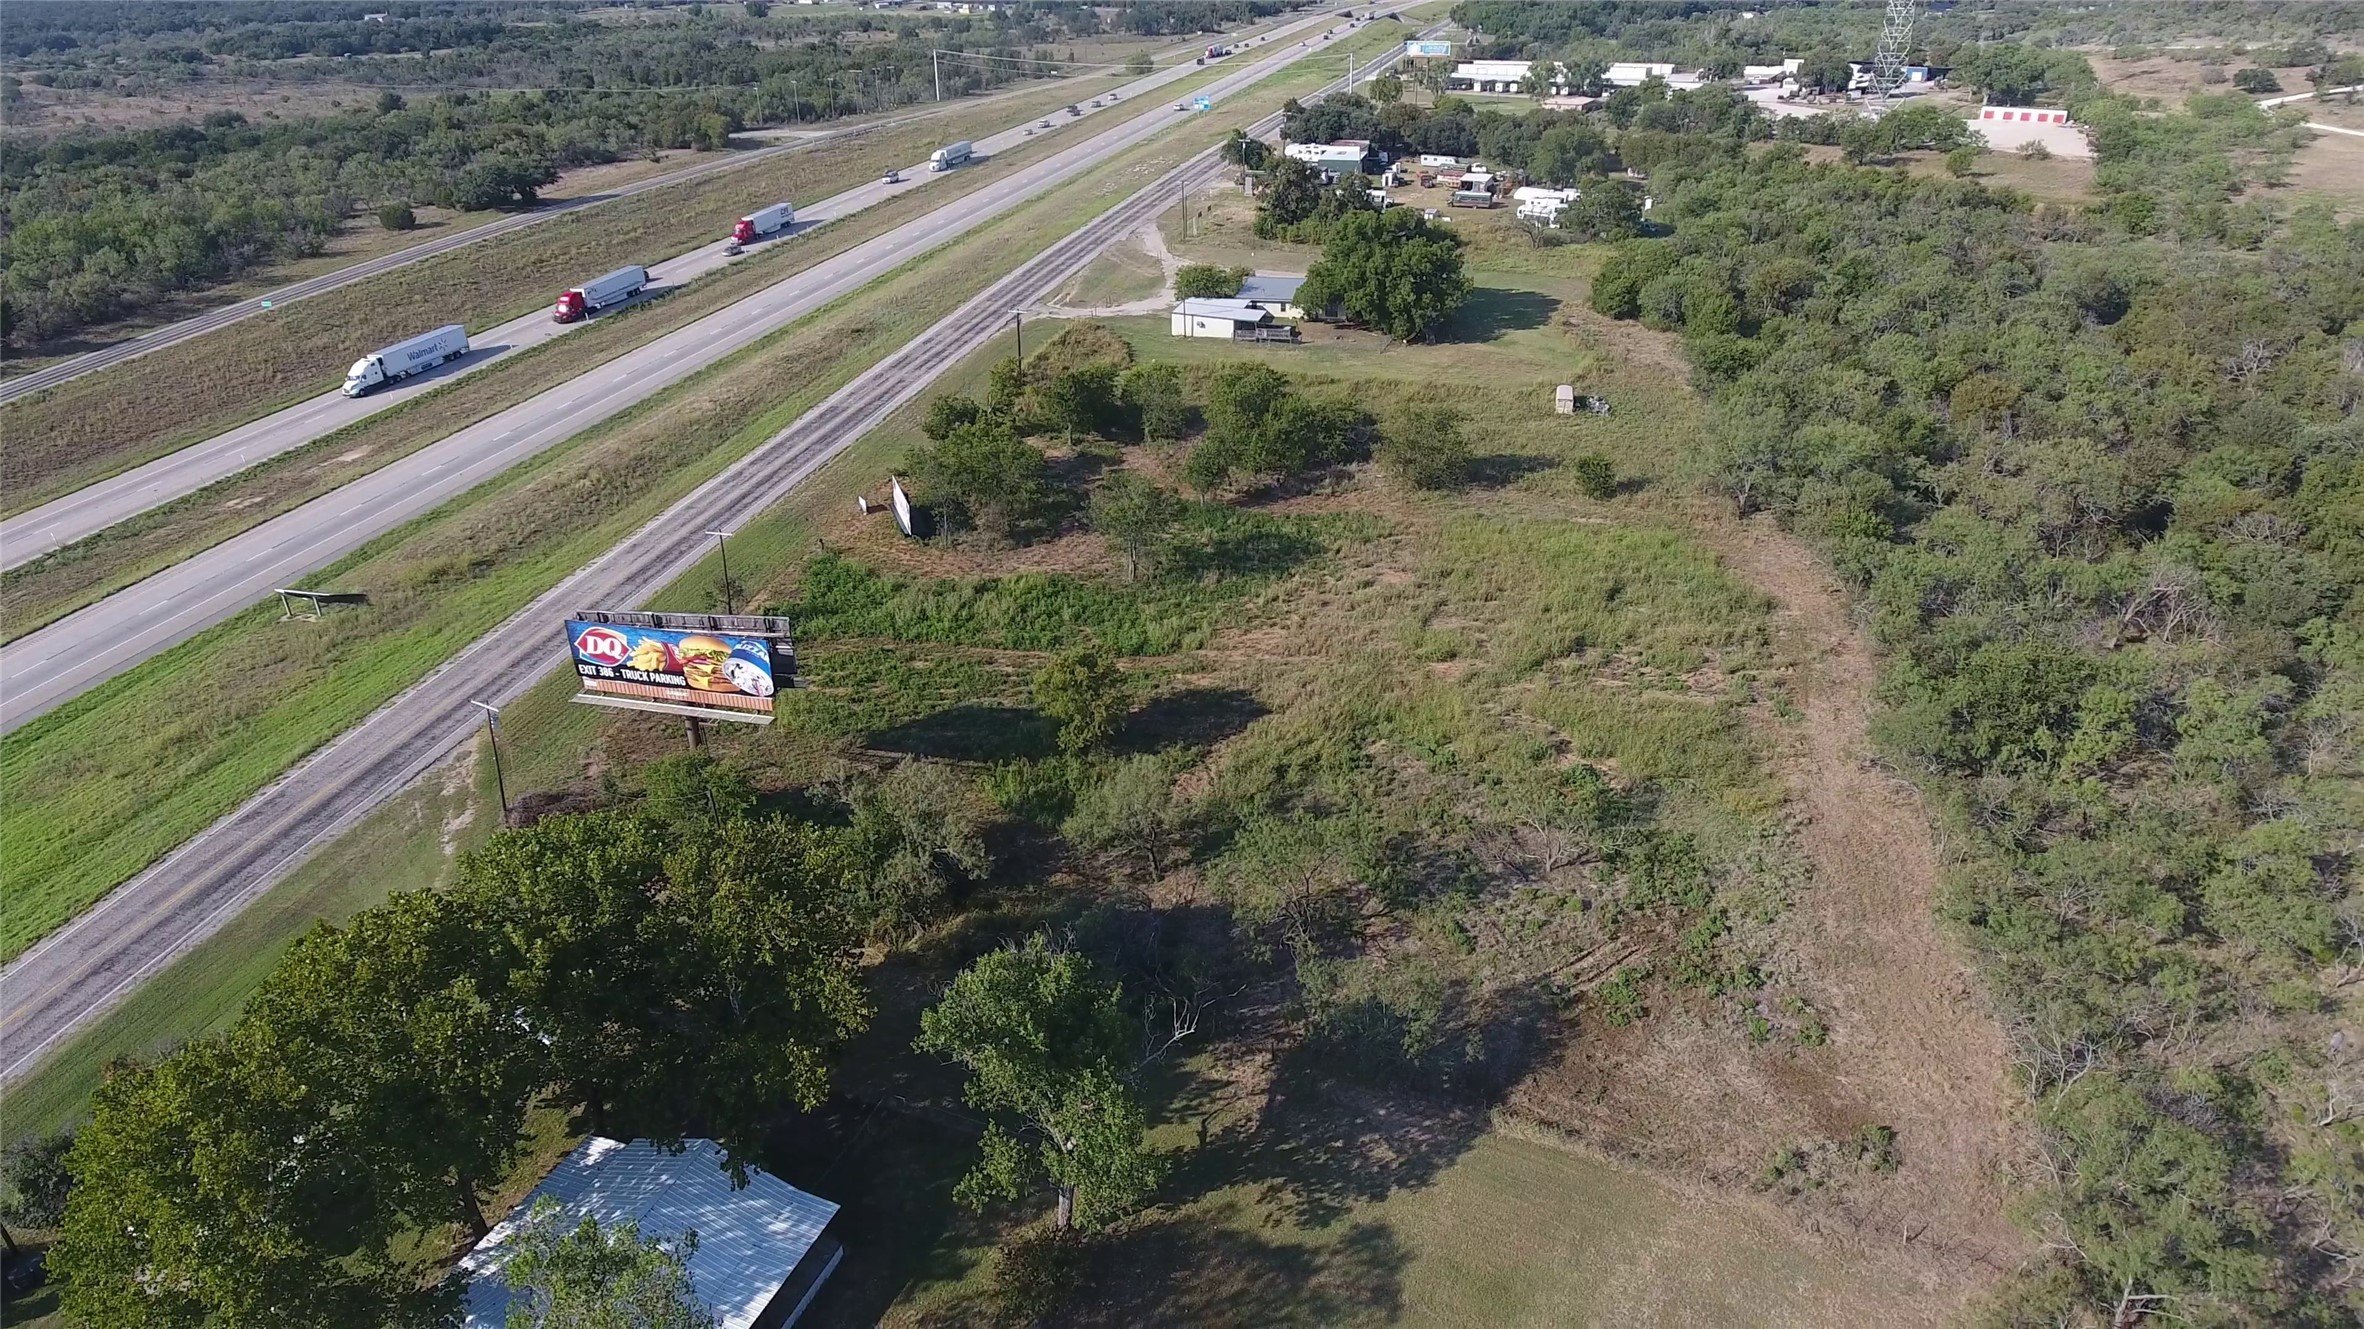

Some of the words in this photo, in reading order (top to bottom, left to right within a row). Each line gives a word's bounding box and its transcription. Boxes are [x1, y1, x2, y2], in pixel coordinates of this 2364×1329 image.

[407, 343, 438, 361] Walmart
[585, 635, 622, 660] DQ
[578, 664, 596, 676] EXIT
[599, 666, 614, 678] 386
[620, 669, 649, 682] TRUCK
[649, 672, 686, 686] PARKING
